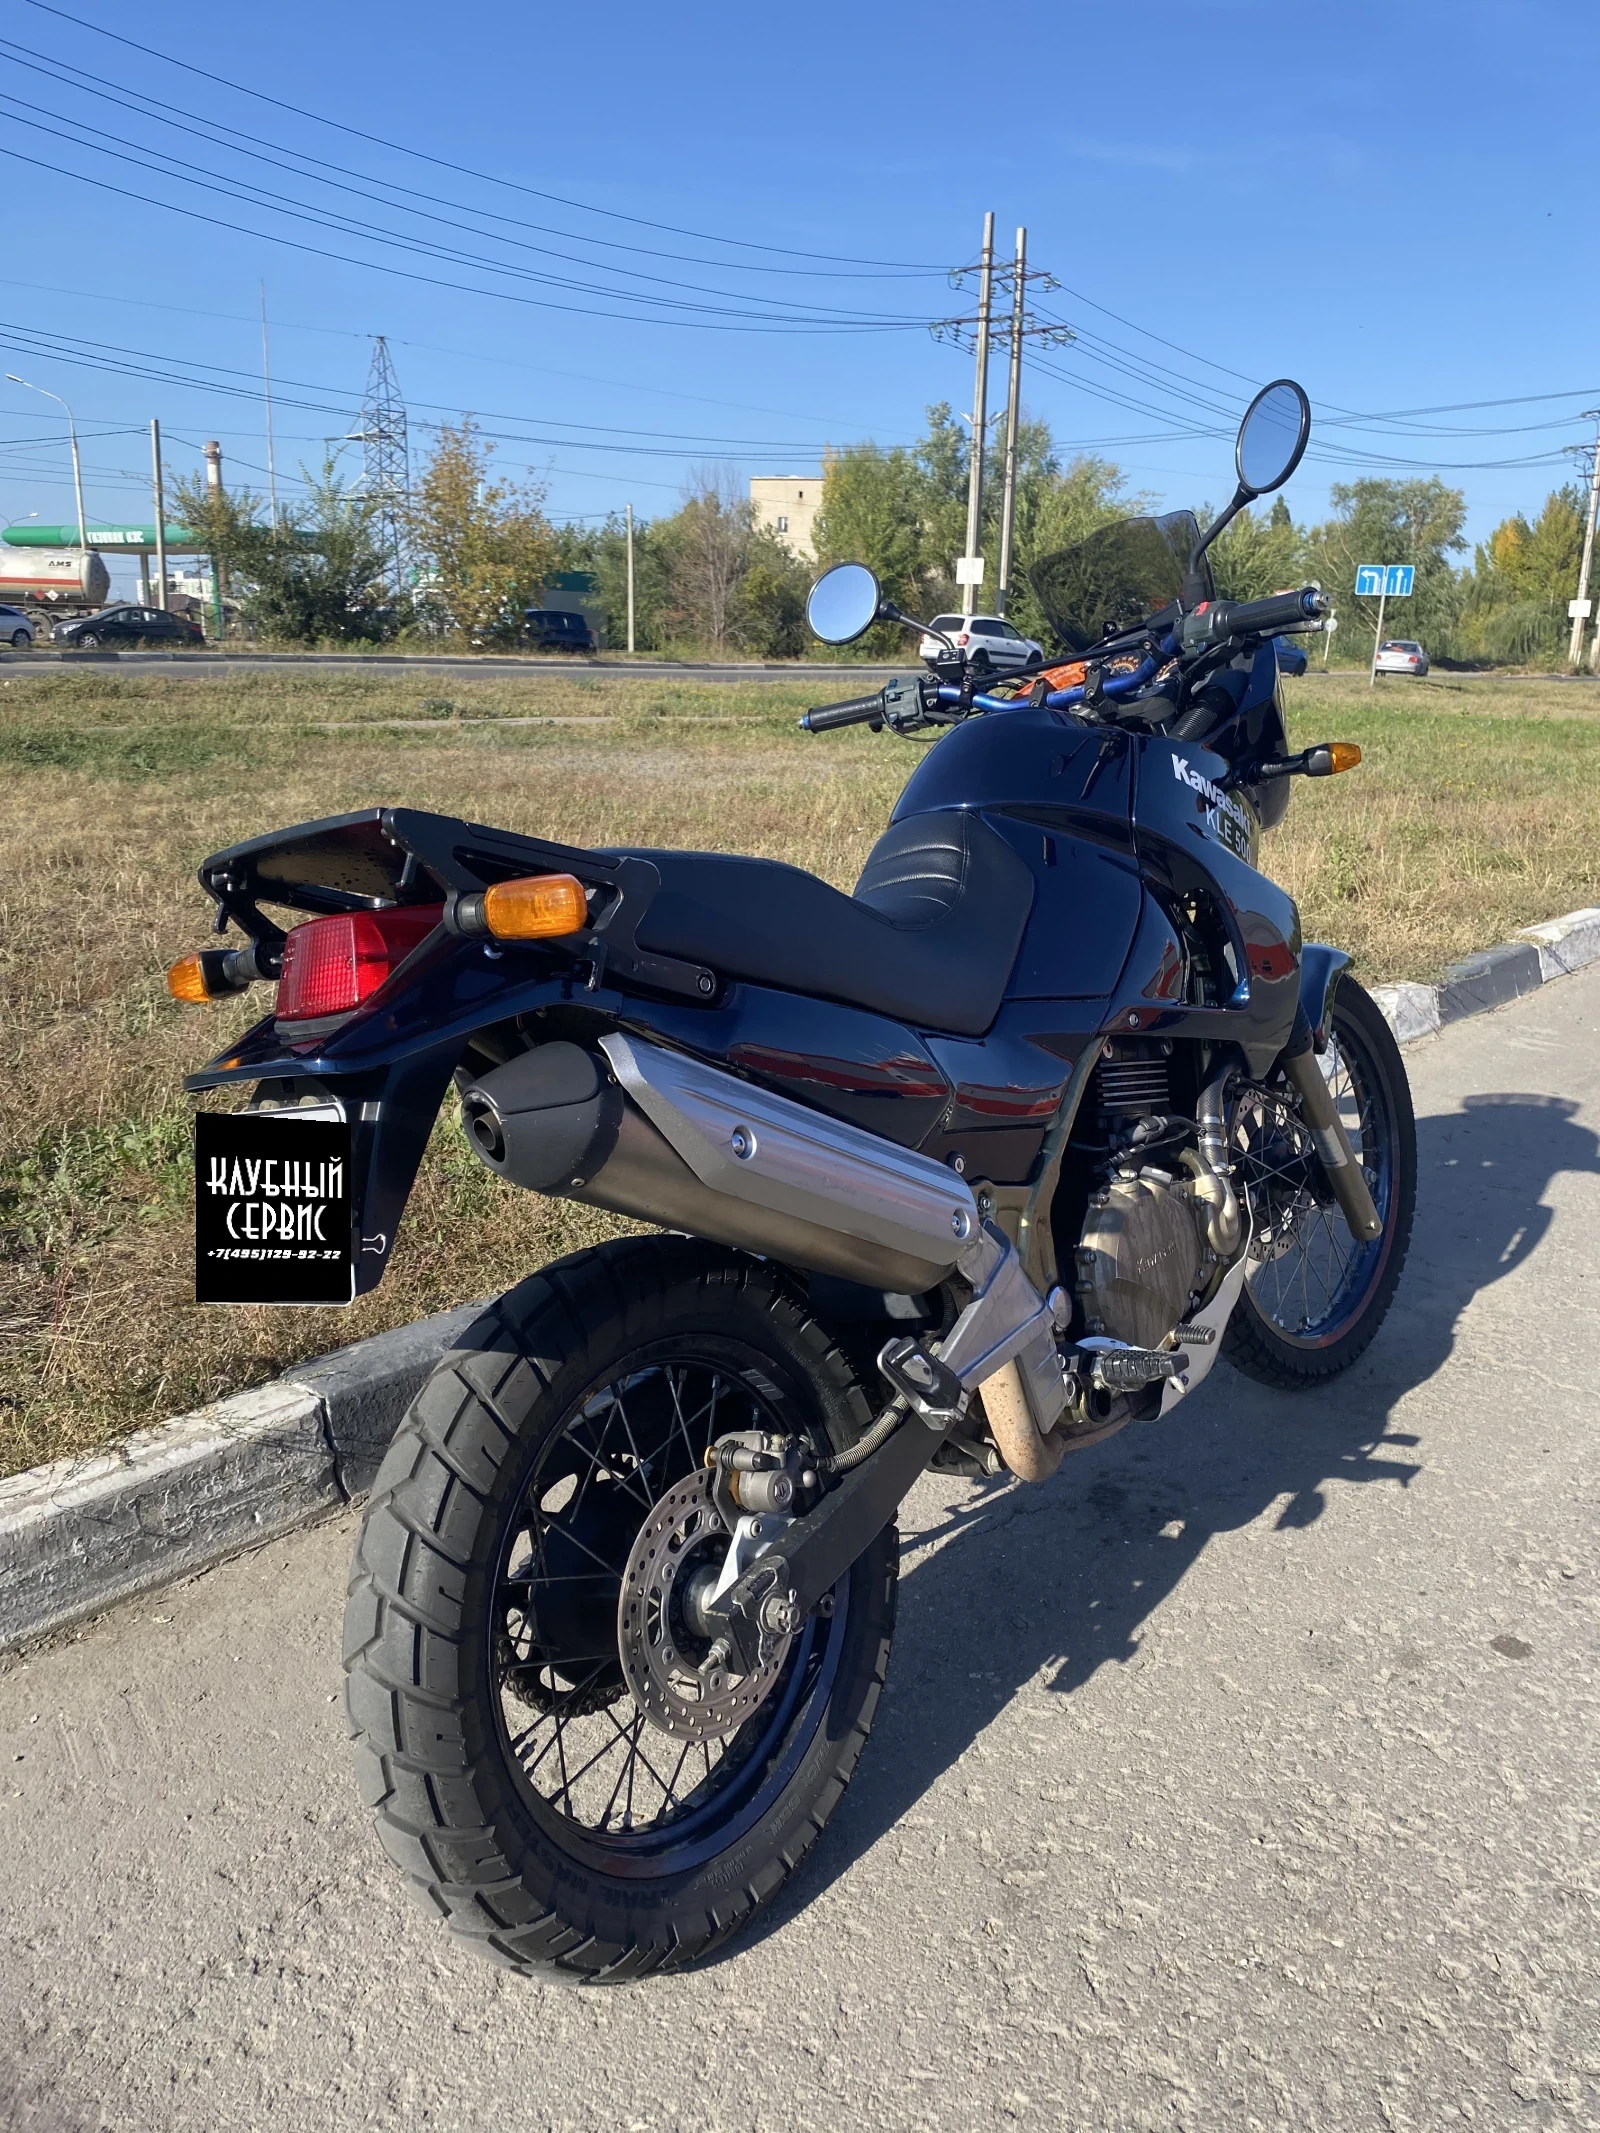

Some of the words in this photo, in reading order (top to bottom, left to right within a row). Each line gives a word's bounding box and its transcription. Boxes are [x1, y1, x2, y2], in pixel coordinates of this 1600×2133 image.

[1171, 753, 1251, 838] Kawasaki
[1205, 803, 1232, 844] KLE
[1235, 830, 1251, 865] 500
